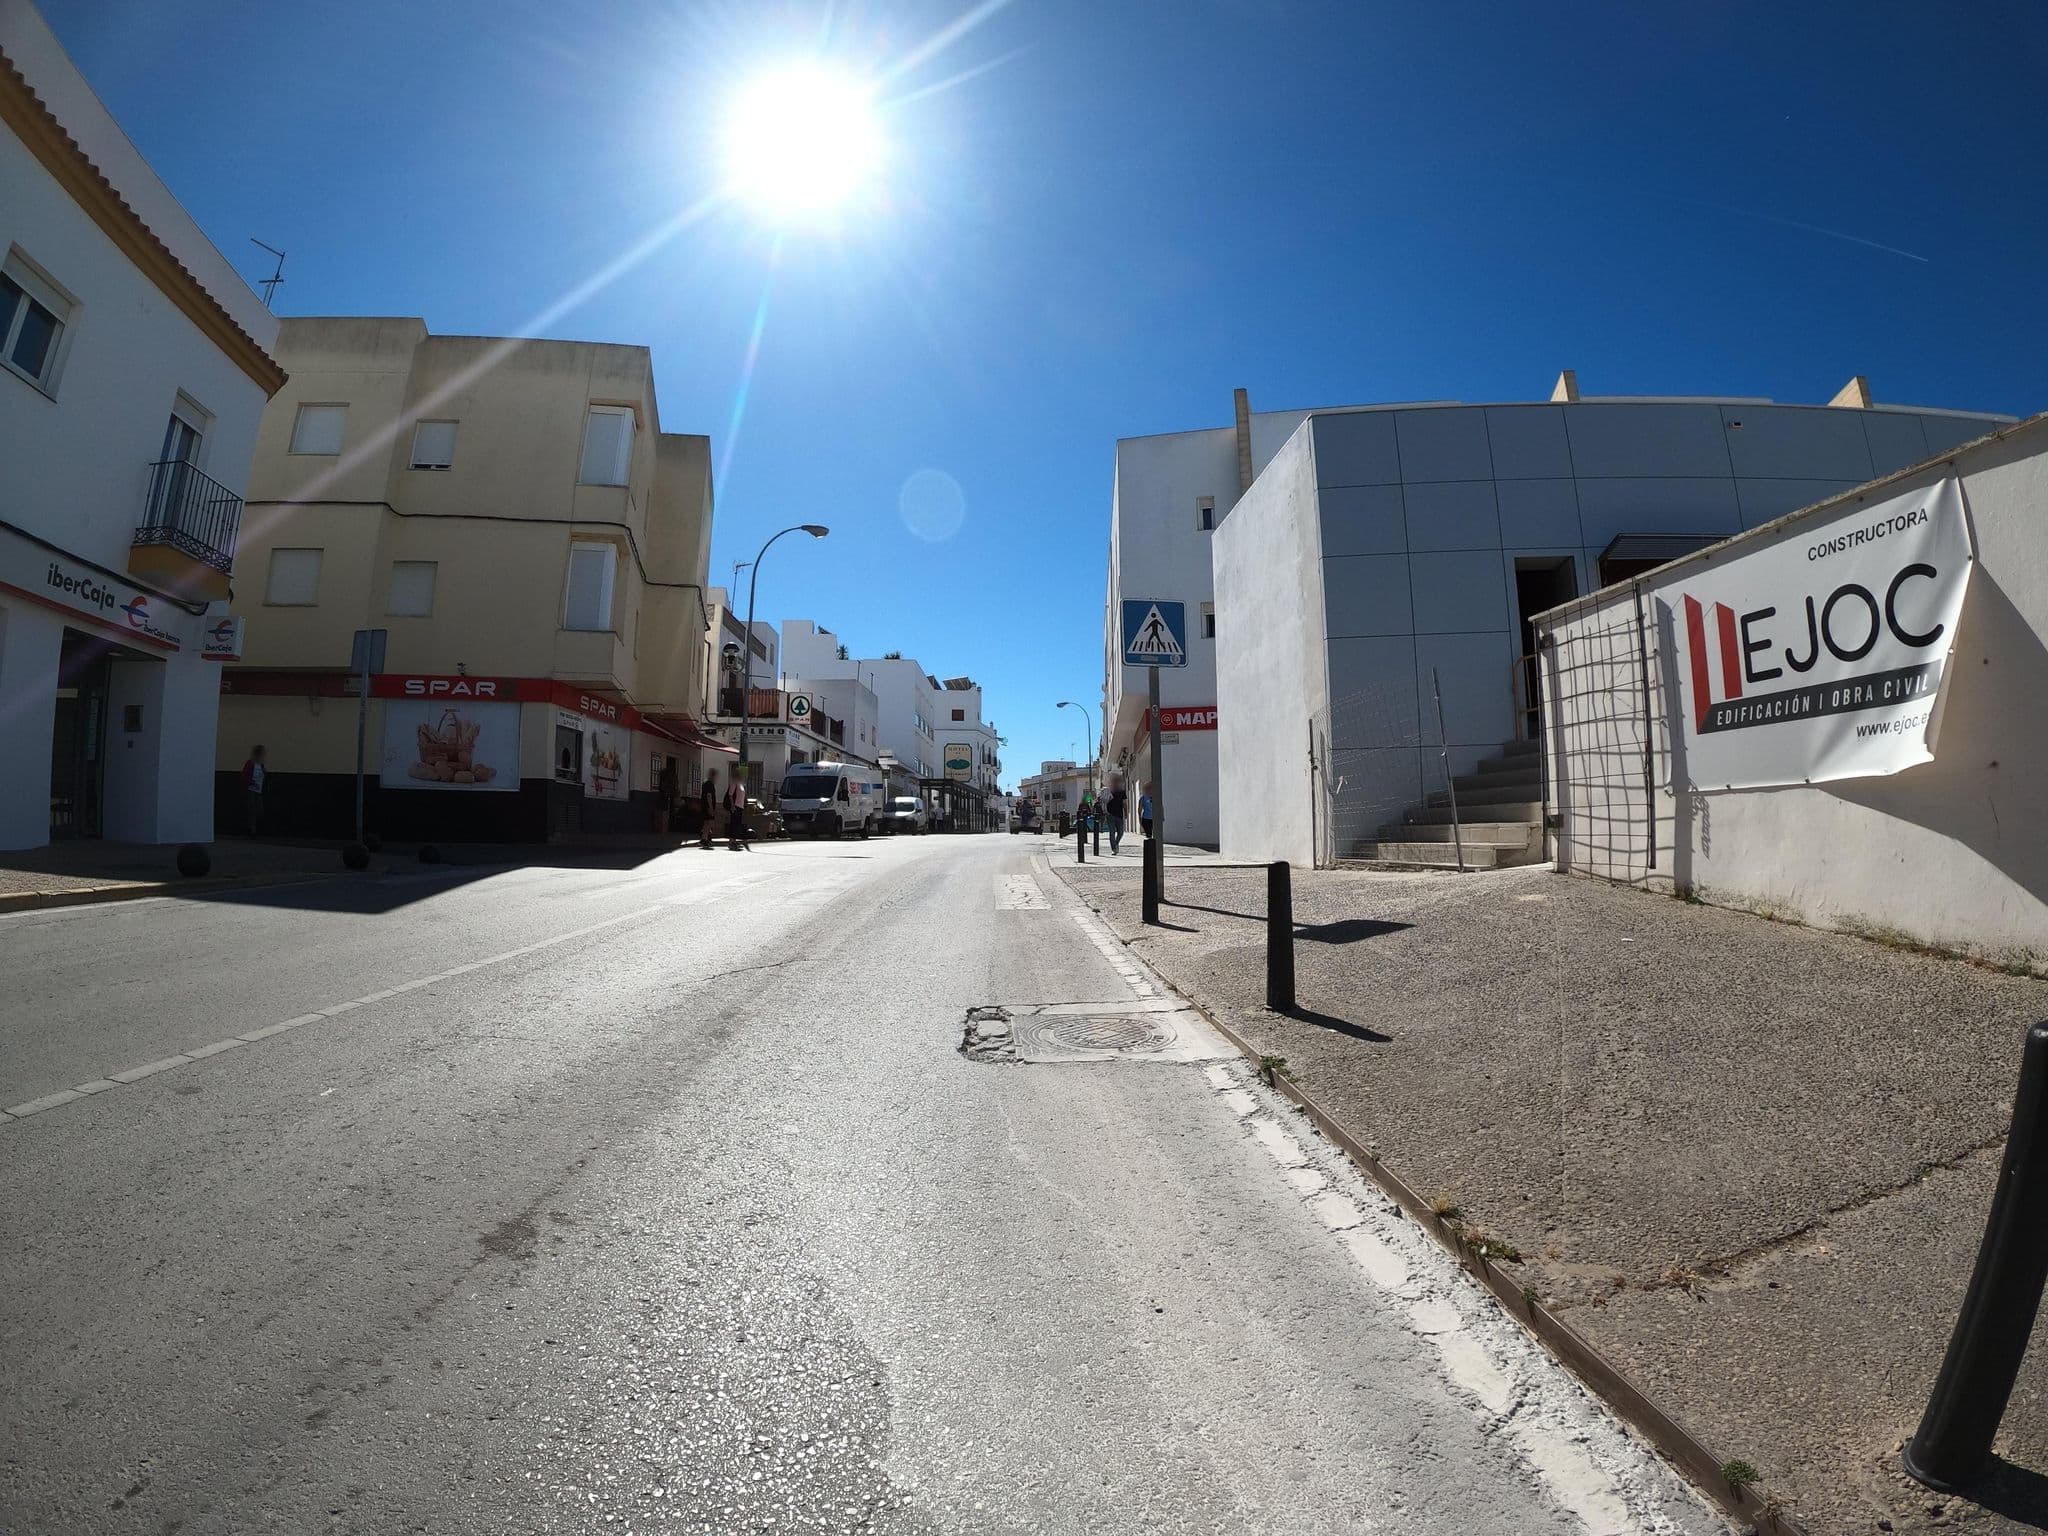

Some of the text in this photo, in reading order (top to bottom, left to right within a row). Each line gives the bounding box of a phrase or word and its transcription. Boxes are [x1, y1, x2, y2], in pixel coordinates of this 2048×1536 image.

[1808, 508, 1928, 561] CONSTRUCTORA
[47, 563, 115, 610] iberCaja
[1740, 563, 1944, 683] EJOC
[405, 679, 496, 696] SPAR
[580, 695, 616, 720] SPAR
[1717, 692, 1810, 726] EDIFICACIÓN
[1832, 684, 1873, 707] OBRA
[1883, 674, 1929, 699] CIVIL
